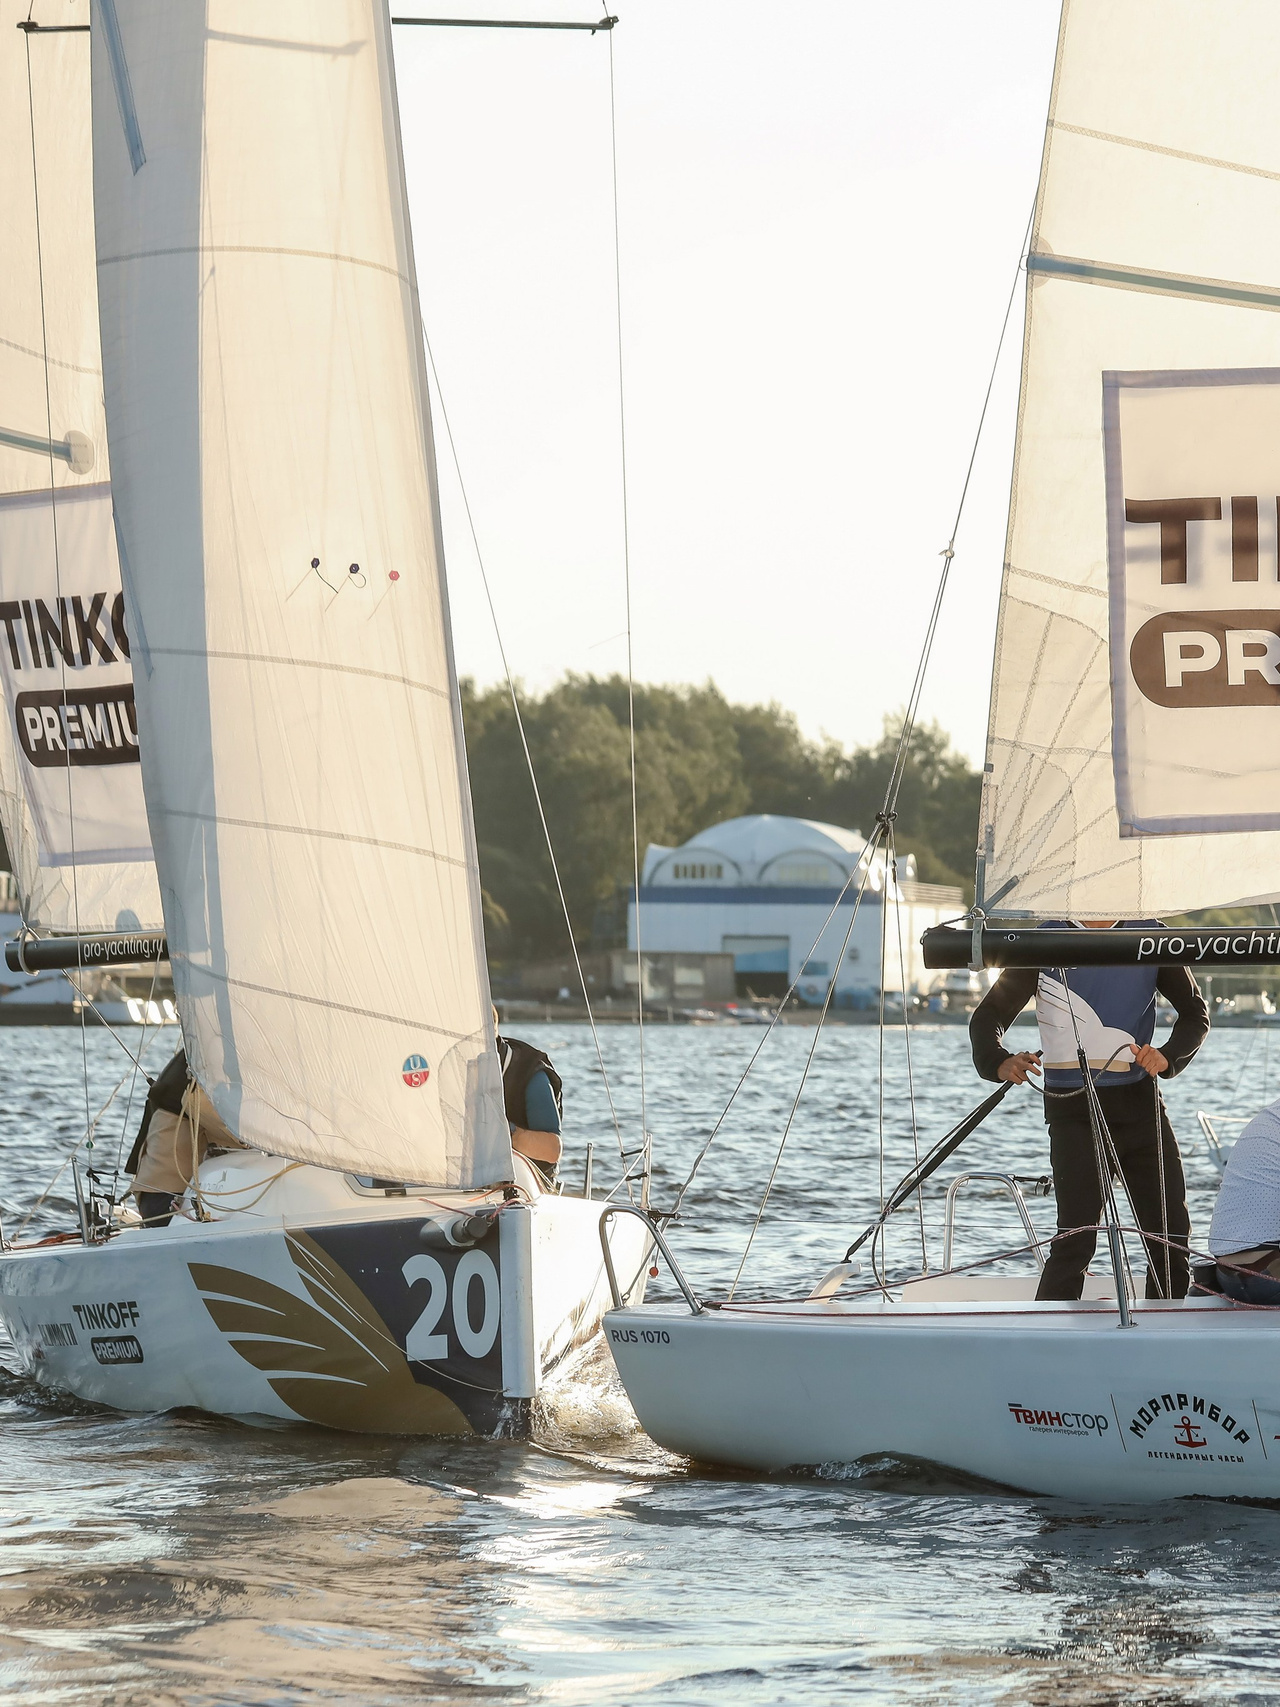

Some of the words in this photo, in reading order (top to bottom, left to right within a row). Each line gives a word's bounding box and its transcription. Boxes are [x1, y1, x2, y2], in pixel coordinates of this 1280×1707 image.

[84, 936, 164, 962] pro-yachting.ru
[72, 1301, 140, 1330] TINKOFF
[401, 1249, 500, 1362] 20
[93, 1340, 140, 1359] PREMIUM
[611, 1329, 638, 1343] RUS
[641, 1331, 670, 1344] 1070
[1129, 1393, 1251, 1445] МОРПРИБОР
[1147, 1451, 1215, 1462] ЛЕГЕНДАРНЫЕ
[1218, 1455, 1245, 1463] ЧАСЫ
